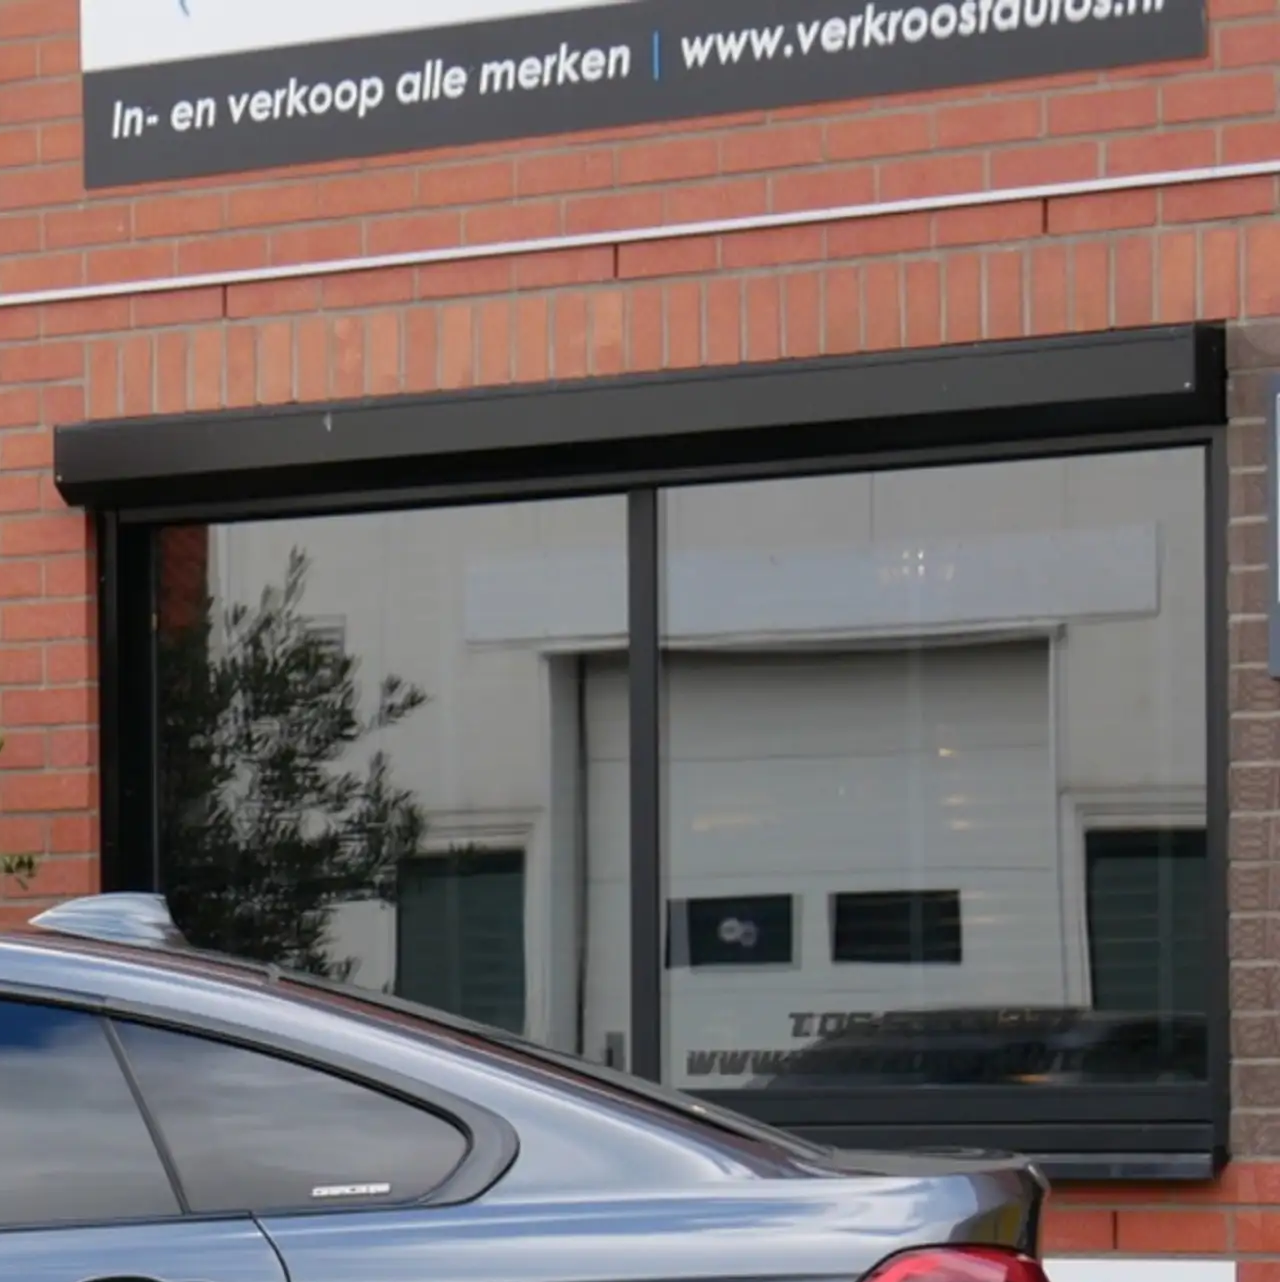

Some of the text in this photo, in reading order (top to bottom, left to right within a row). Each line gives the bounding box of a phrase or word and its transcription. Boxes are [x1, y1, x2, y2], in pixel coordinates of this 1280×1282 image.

[112, 100, 159, 139] In-
[170, 97, 216, 131] en
[228, 77, 385, 124] verkoop
[395, 58, 468, 104] alle
[479, 42, 631, 94] merken
